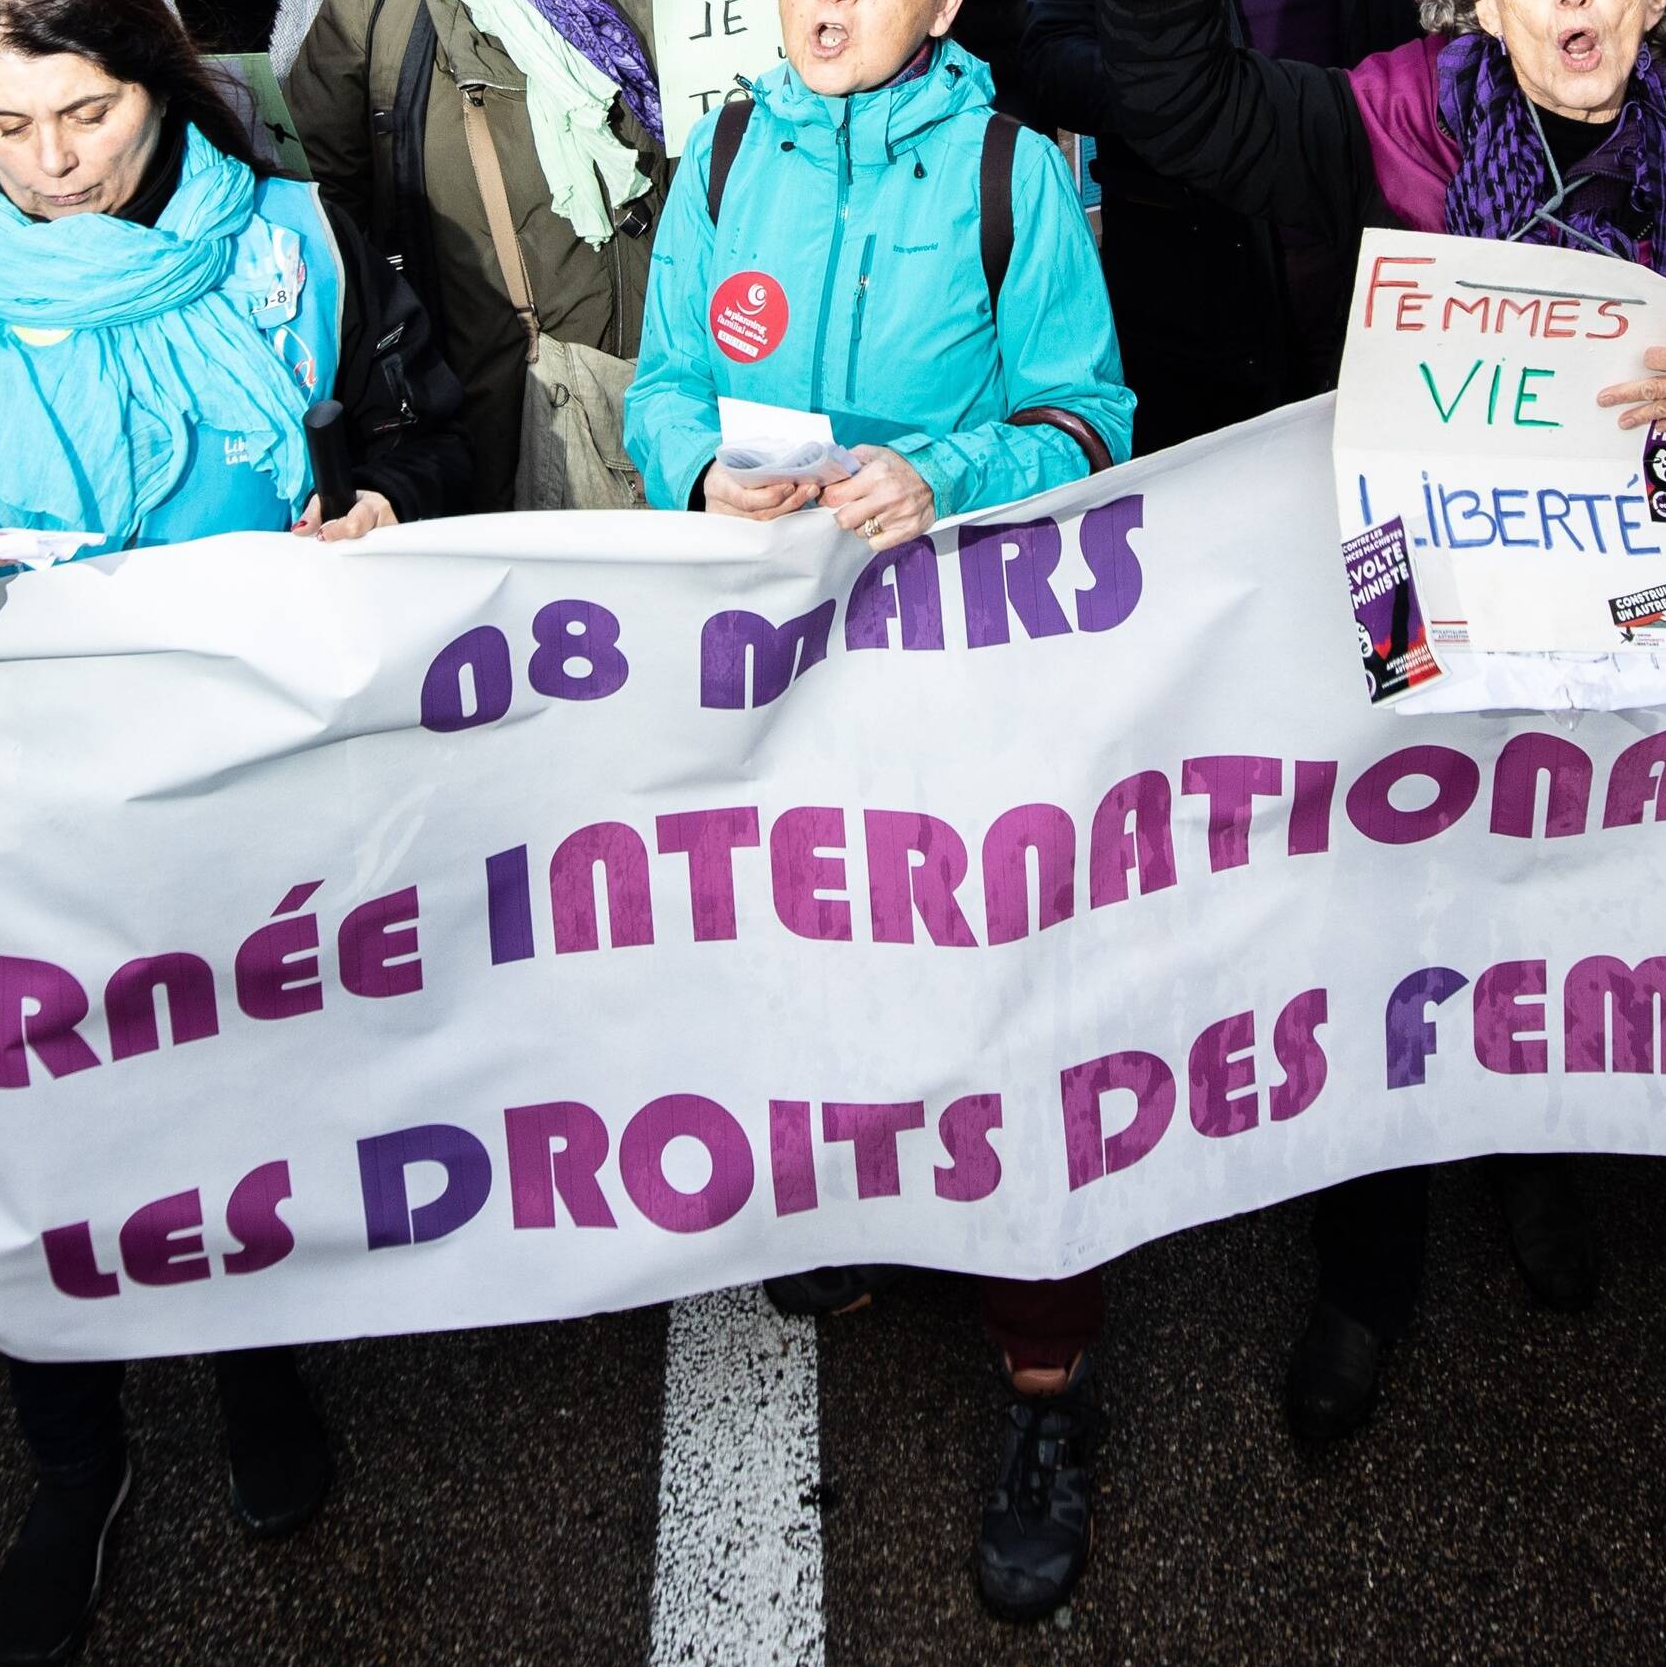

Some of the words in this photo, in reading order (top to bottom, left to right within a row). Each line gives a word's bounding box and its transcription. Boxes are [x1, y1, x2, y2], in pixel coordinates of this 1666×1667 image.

[1363, 256, 1631, 340] FEMMES
[420, 598, 630, 733] 08
[700, 494, 1145, 710] MARS
[1351, 560, 1410, 611] MINISTE
[1616, 609, 1635, 623] UN
[43, 1159, 295, 1300] LES
[356, 1092, 1004, 1252] DROITS
[1060, 987, 1328, 1194] DES
